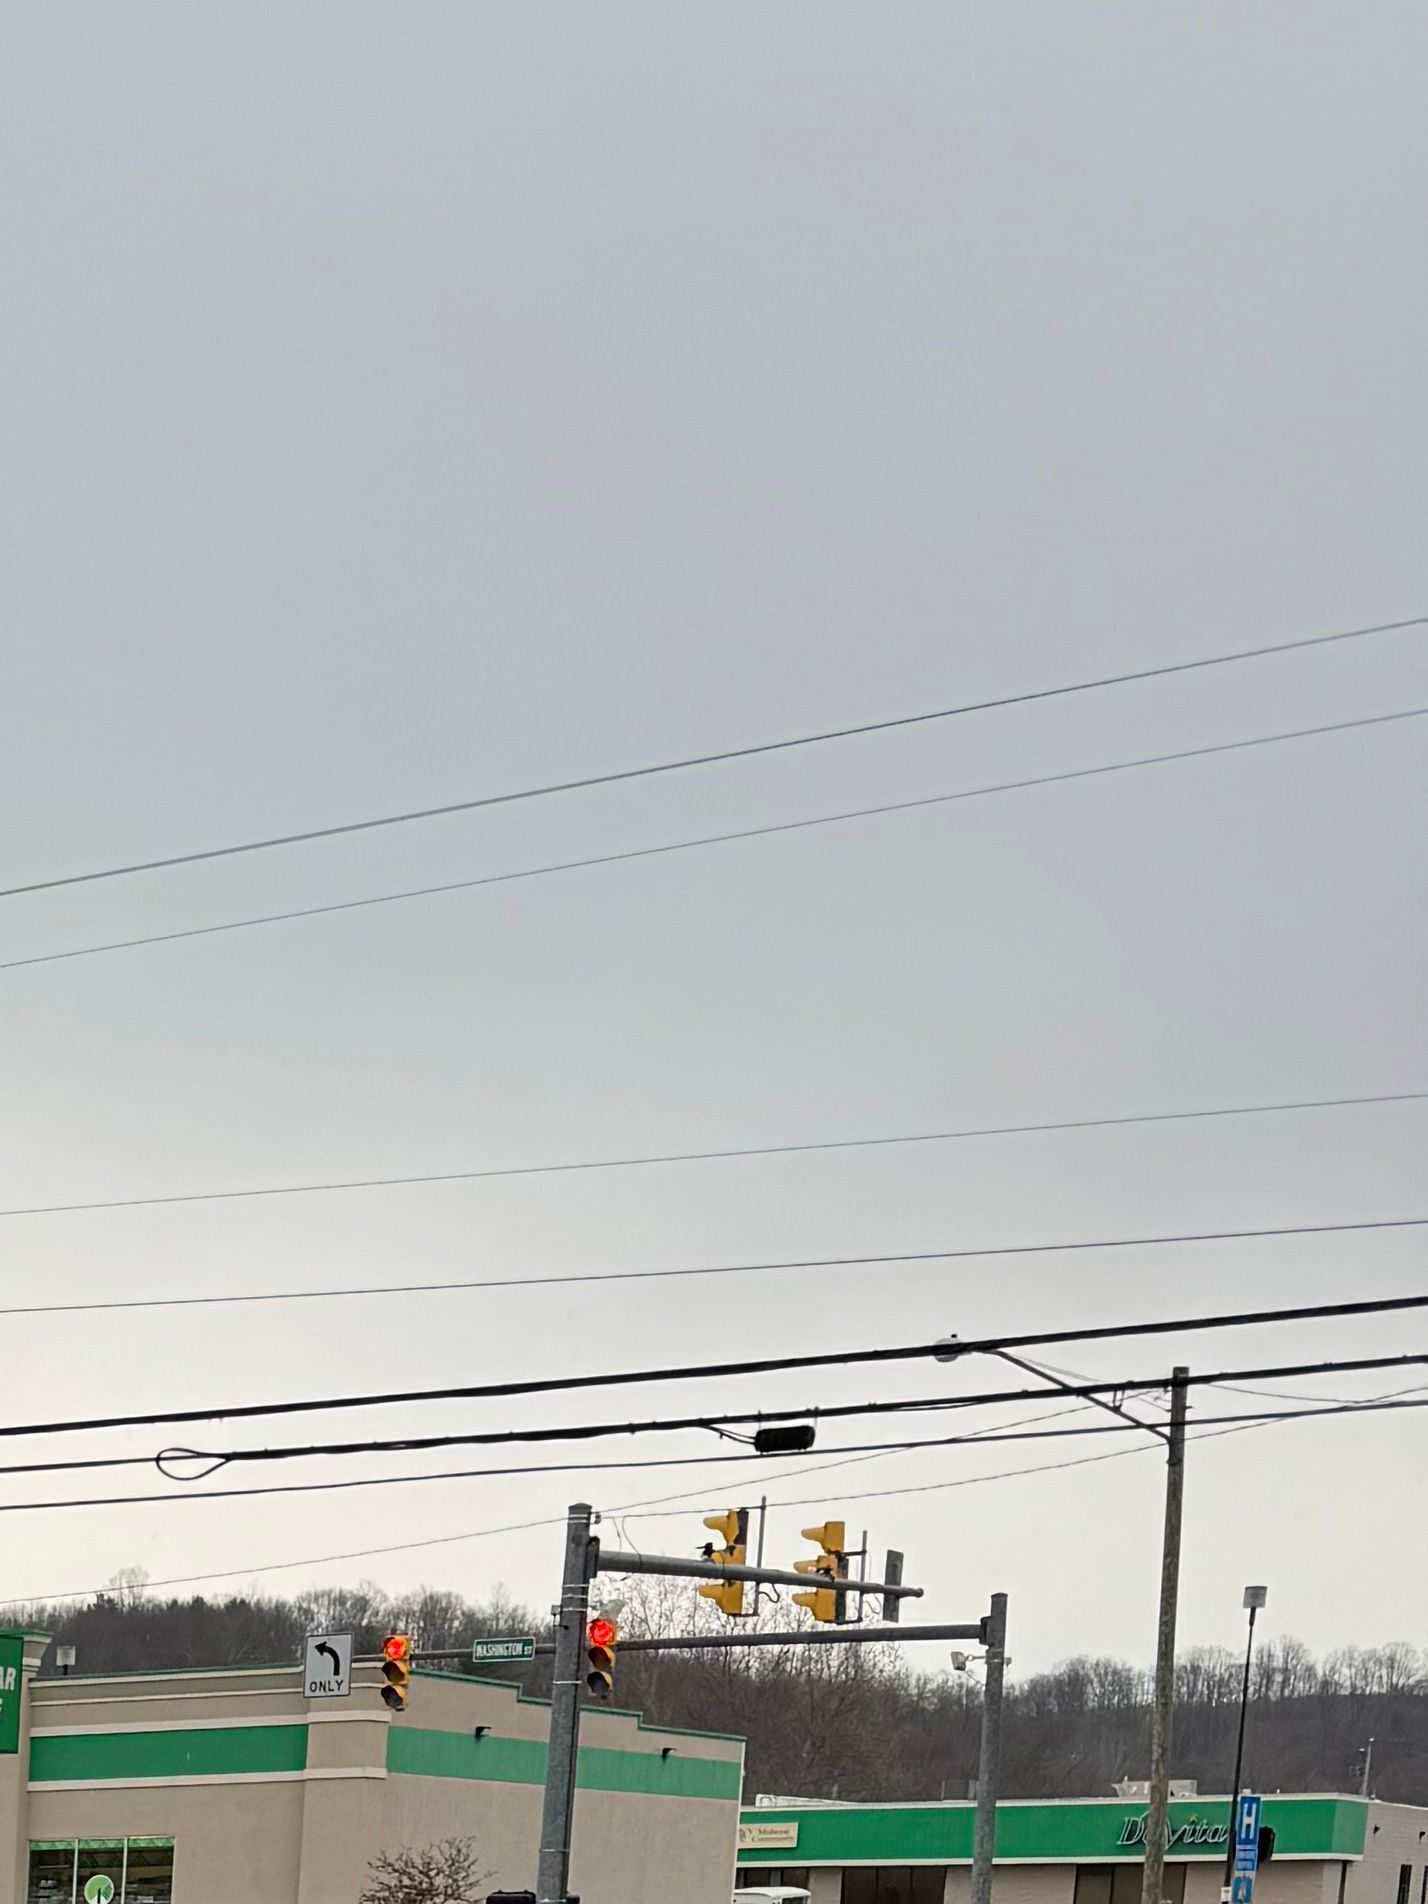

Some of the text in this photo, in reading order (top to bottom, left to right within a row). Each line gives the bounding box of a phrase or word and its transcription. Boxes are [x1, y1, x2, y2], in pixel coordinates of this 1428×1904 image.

[476, 1642, 523, 1656] WASHINGTON
[309, 1680, 344, 1693] ONLY
[1241, 1803, 1257, 1840] H
